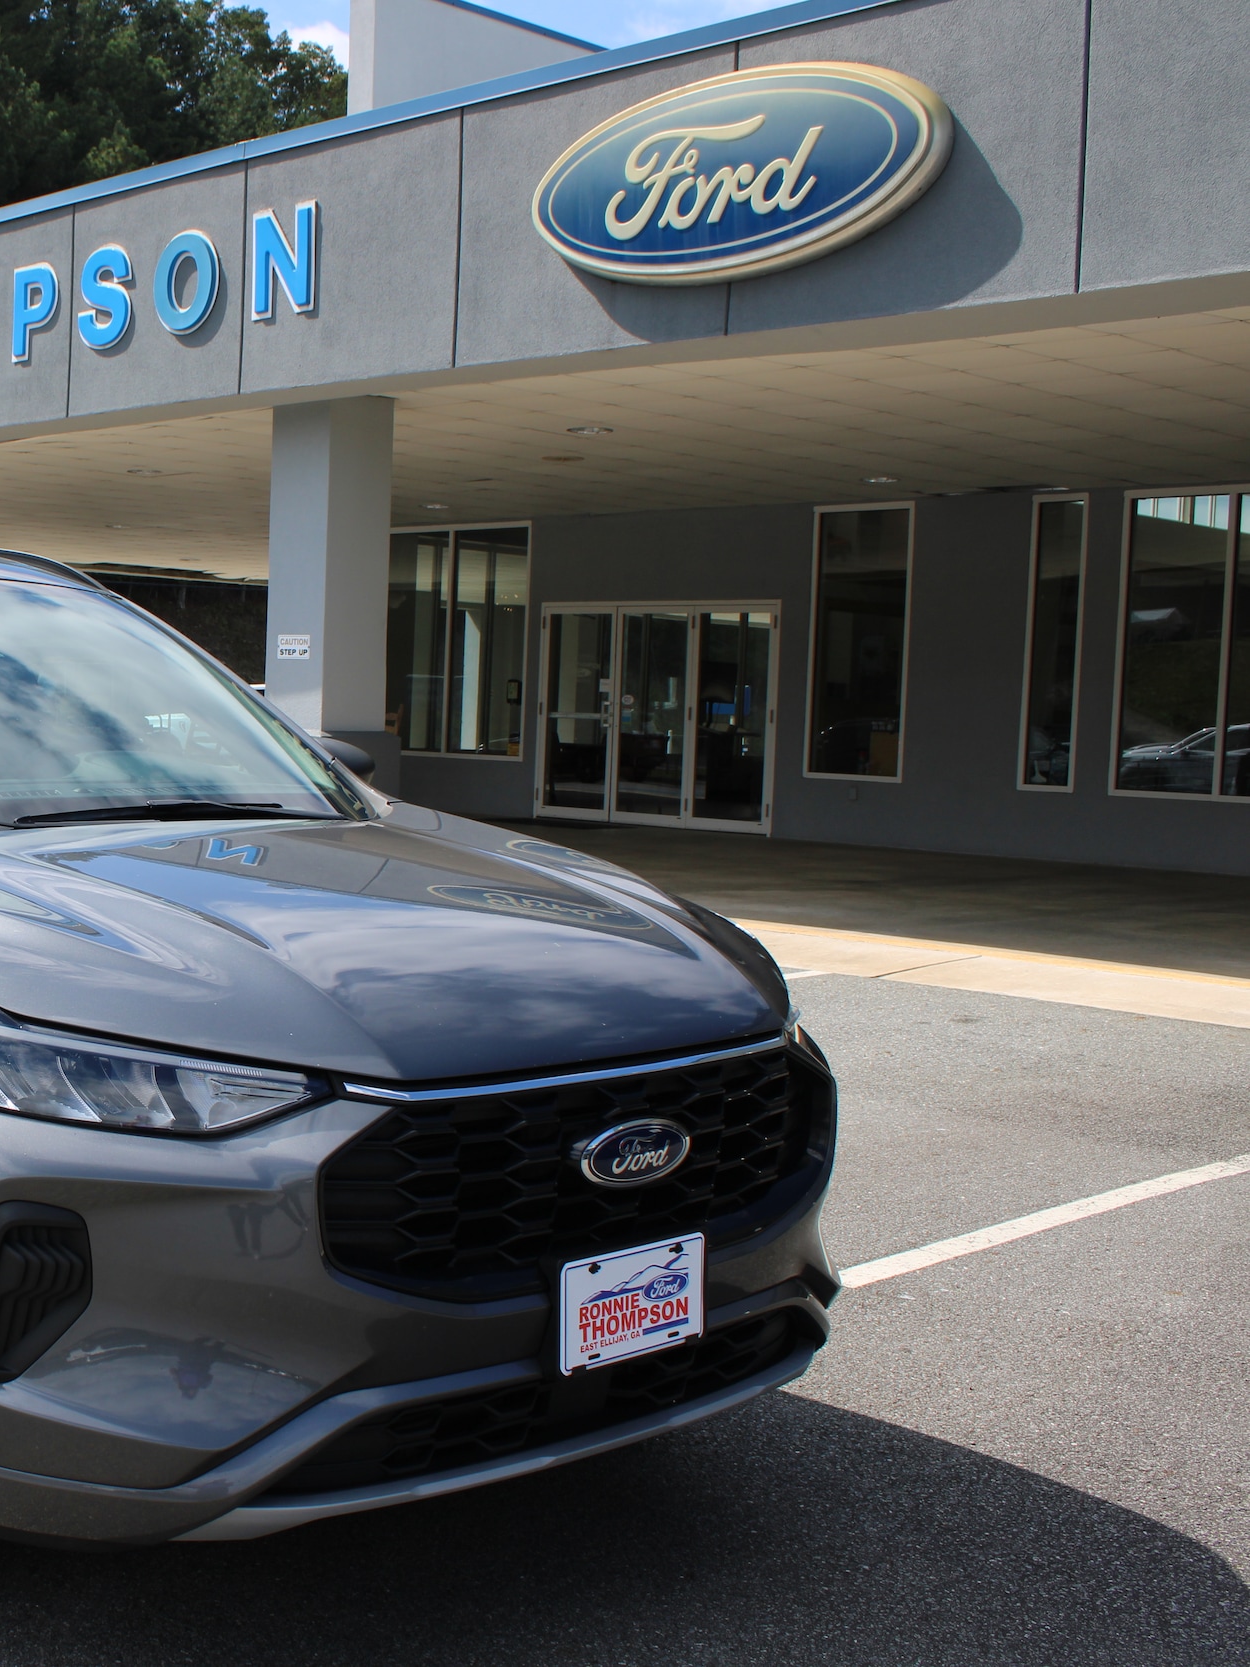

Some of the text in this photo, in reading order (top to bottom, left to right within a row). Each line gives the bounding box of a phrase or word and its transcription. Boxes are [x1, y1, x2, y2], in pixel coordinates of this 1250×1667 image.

[604, 113, 825, 241] Ford
[279, 648, 308, 656] STEP UP
[280, 638, 308, 646] CAUTION
[612, 1133, 671, 1175] Ford
[650, 1276, 681, 1298] Ford
[578, 1296, 689, 1343] THOMPSON
[579, 1292, 640, 1323] RONNIE
[580, 1330, 641, 1353] EAST ELLIJAY, GA
